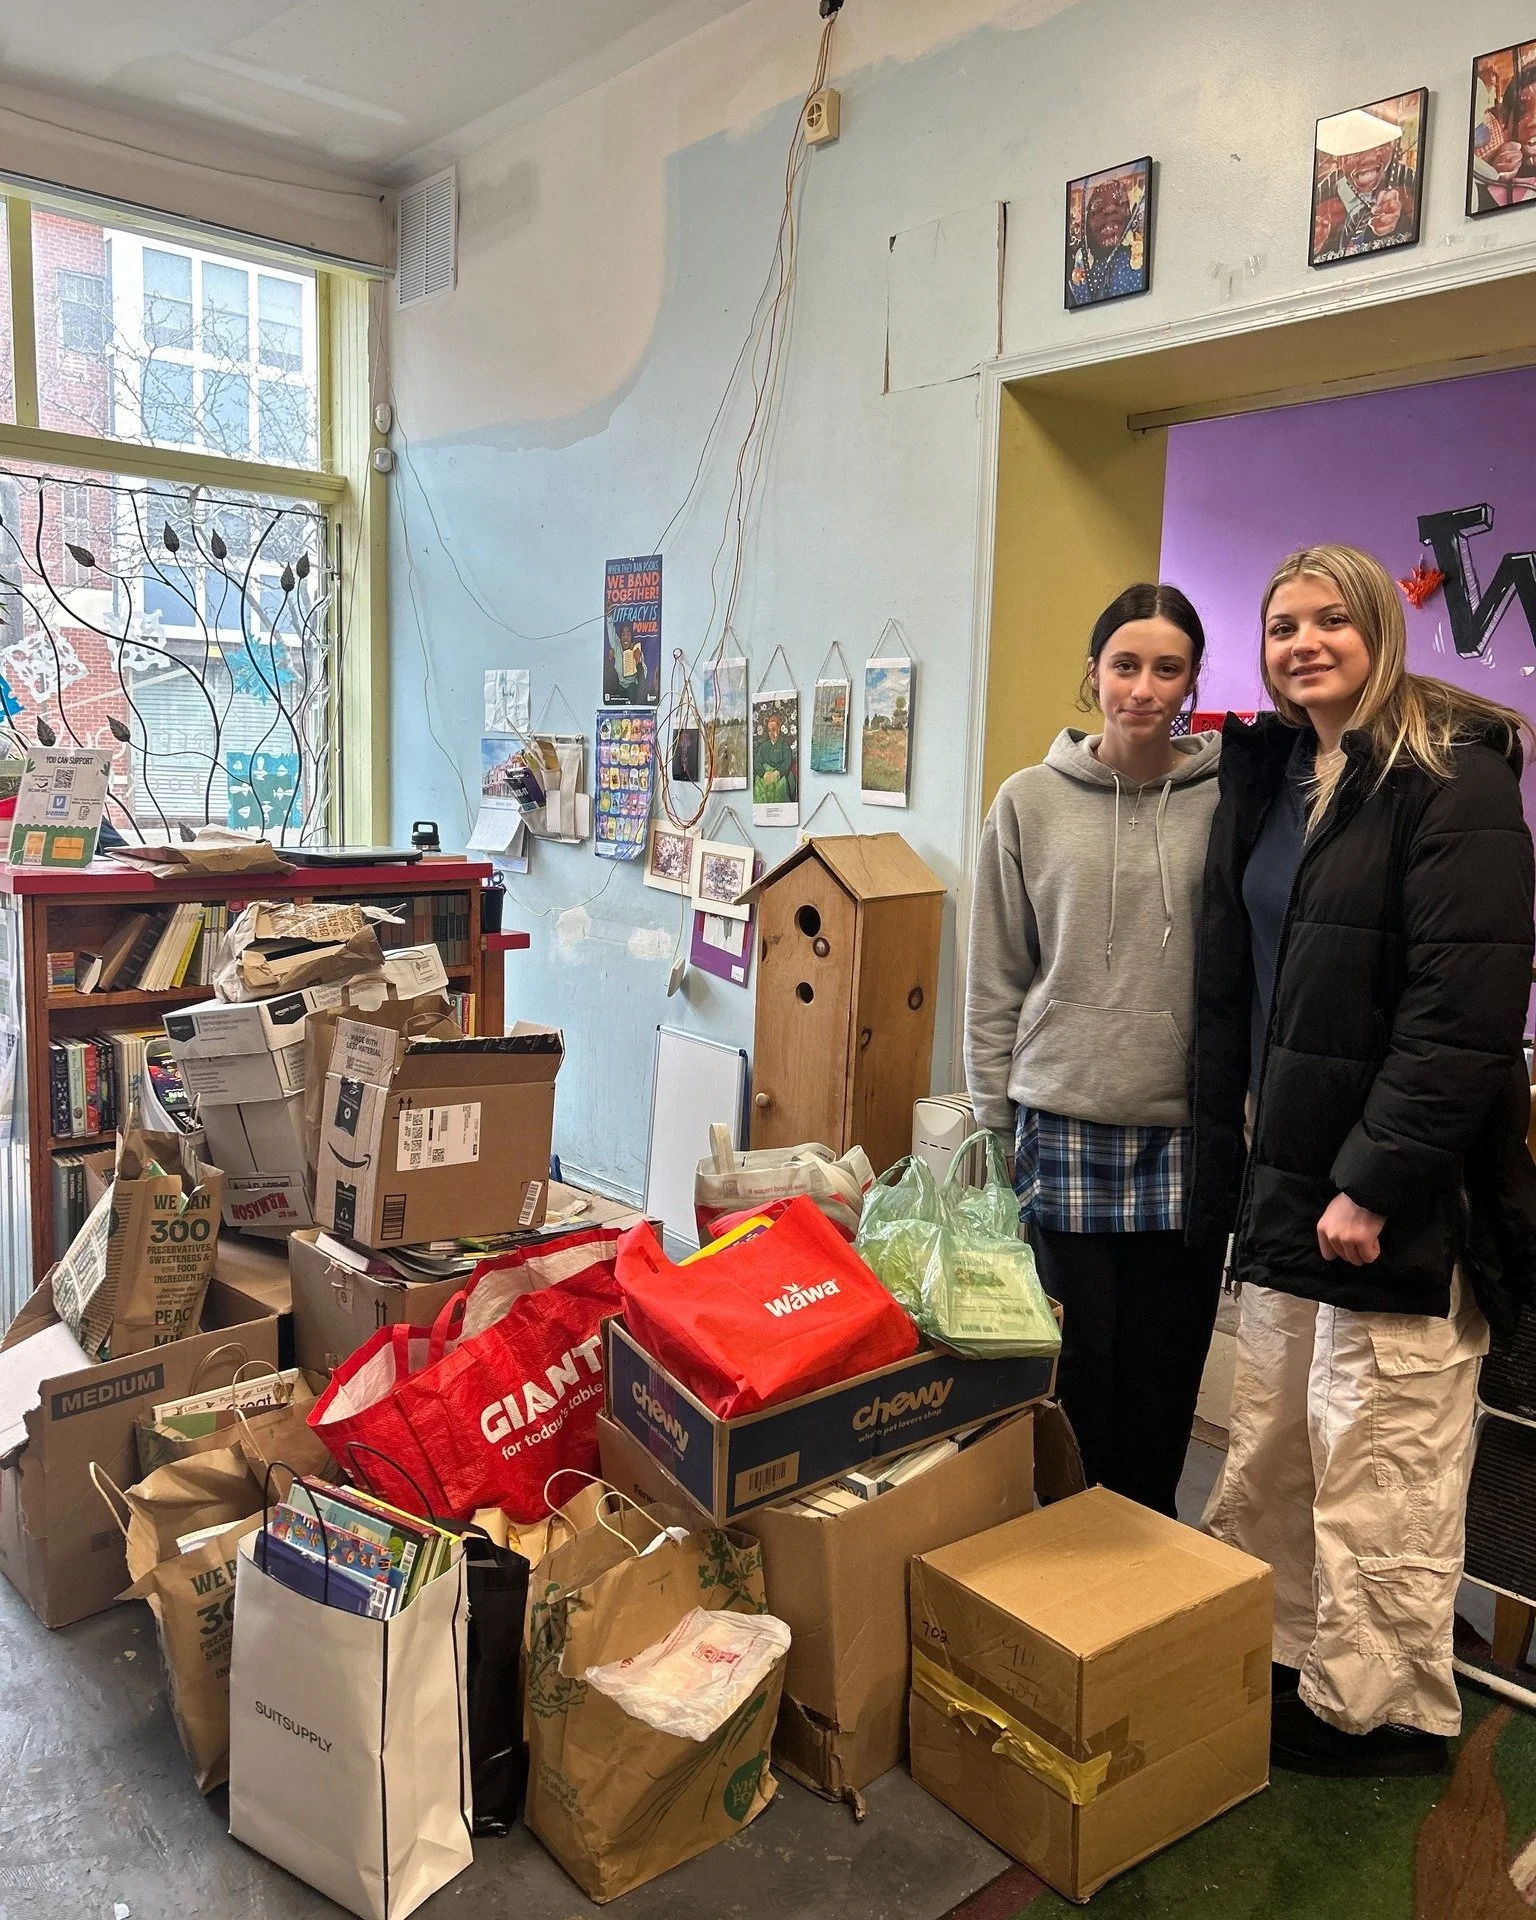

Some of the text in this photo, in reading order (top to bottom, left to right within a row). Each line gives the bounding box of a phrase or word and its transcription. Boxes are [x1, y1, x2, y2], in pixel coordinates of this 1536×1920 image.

[607, 571, 660, 589] WE BAND
[606, 585, 660, 602] TOGETHER!
[613, 605, 658, 622] LITERACY IS
[46, 756, 56, 764] YOU
[69, 757, 93, 765] SUPPORT
[346, 1042, 381, 1057] LESS MATERIAL
[365, 1038, 378, 1047] WITH
[154, 1194, 211, 1210] WE AN
[150, 1219, 210, 1243] 300
[147, 1243, 213, 1254] PRESERVATIVES,
[149, 1253, 210, 1264] SWEETENERS &
[154, 1273, 205, 1284] INGREDIENTS
[155, 1307, 193, 1325] PEAC
[61, 1370, 156, 1413] MEDIUM
[184, 1404, 200, 1412] Look
[257, 1384, 273, 1393] Learn
[480, 1335, 601, 1444] GIANT
[852, 1378, 954, 1431] chewy
[502, 1382, 603, 1460] for today's table
[632, 1381, 689, 1452] chewy
[898, 1415, 922, 1428] lovers
[923, 1409, 942, 1420] shop
[190, 1567, 226, 1596] WE
[255, 1700, 332, 1753] SUITSUPPLY
